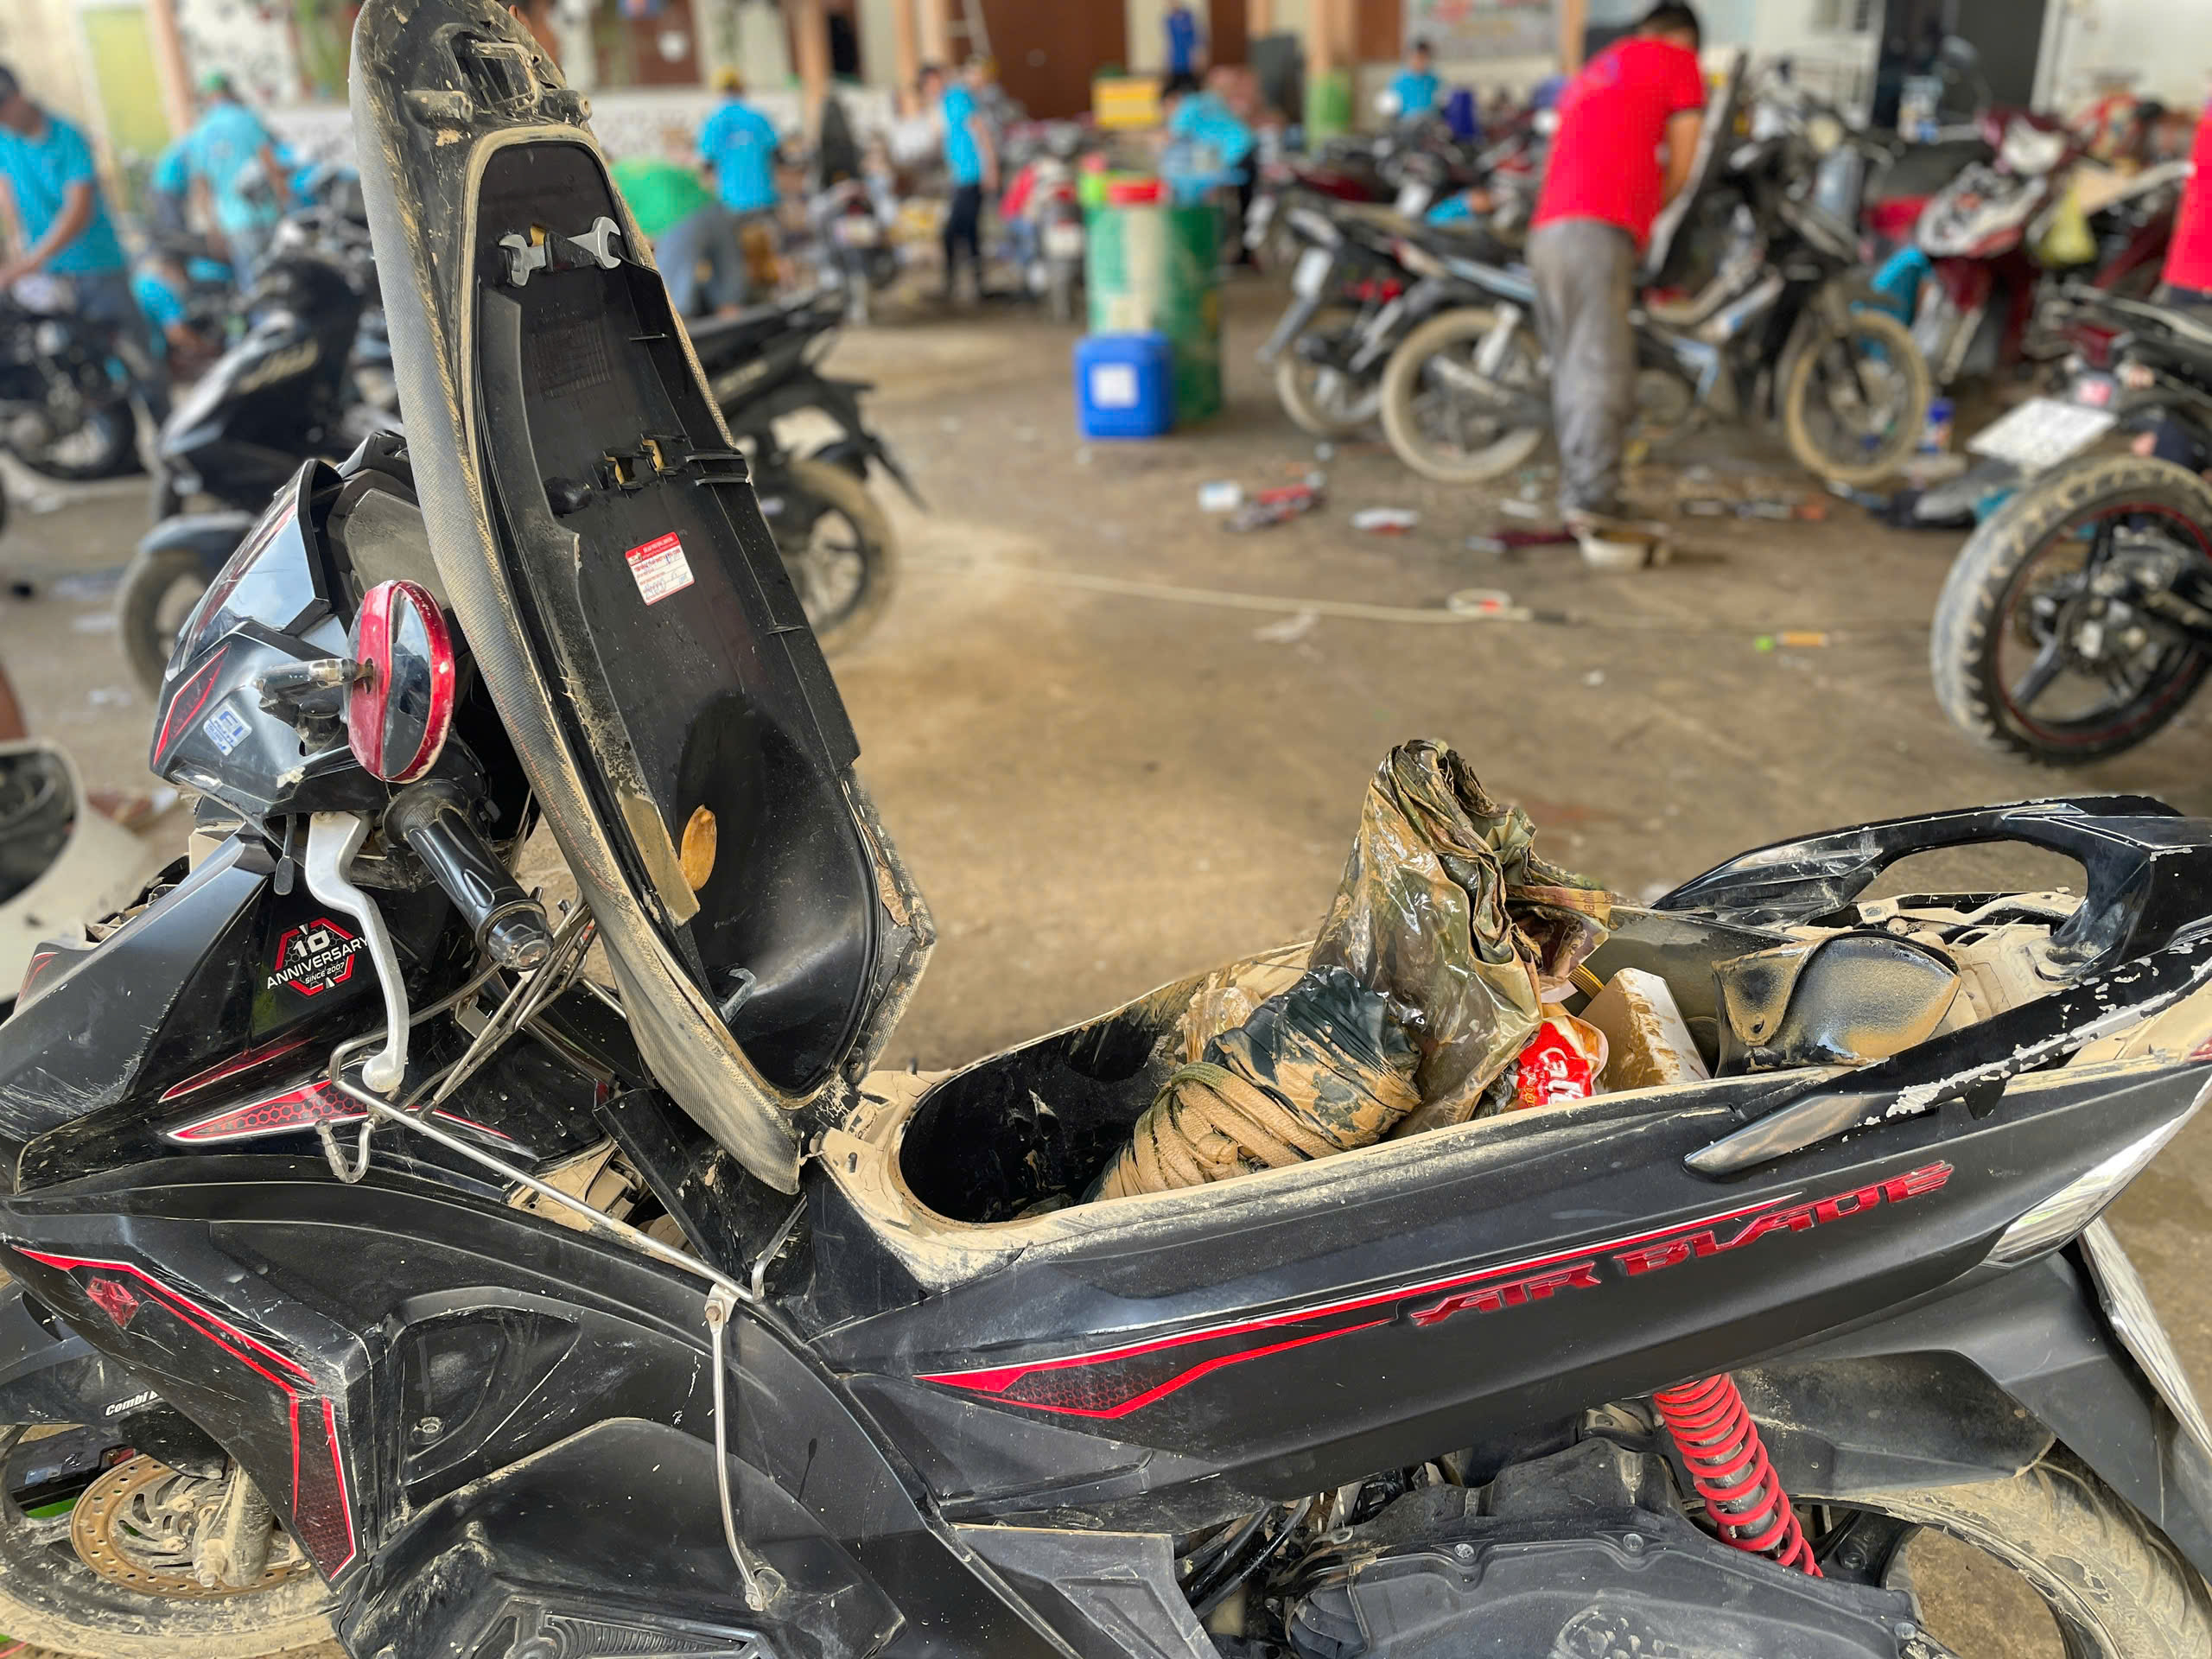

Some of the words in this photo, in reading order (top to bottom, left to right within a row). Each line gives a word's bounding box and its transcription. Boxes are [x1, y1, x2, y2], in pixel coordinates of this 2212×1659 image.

[266, 937, 368, 989] ANNIVERSARY
[293, 930, 330, 957] 10
[305, 970, 326, 984] SINCE
[327, 962, 346, 976] 2007
[1410, 1261, 1602, 1326] AIR
[1613, 1160, 1955, 1277] BLADE
